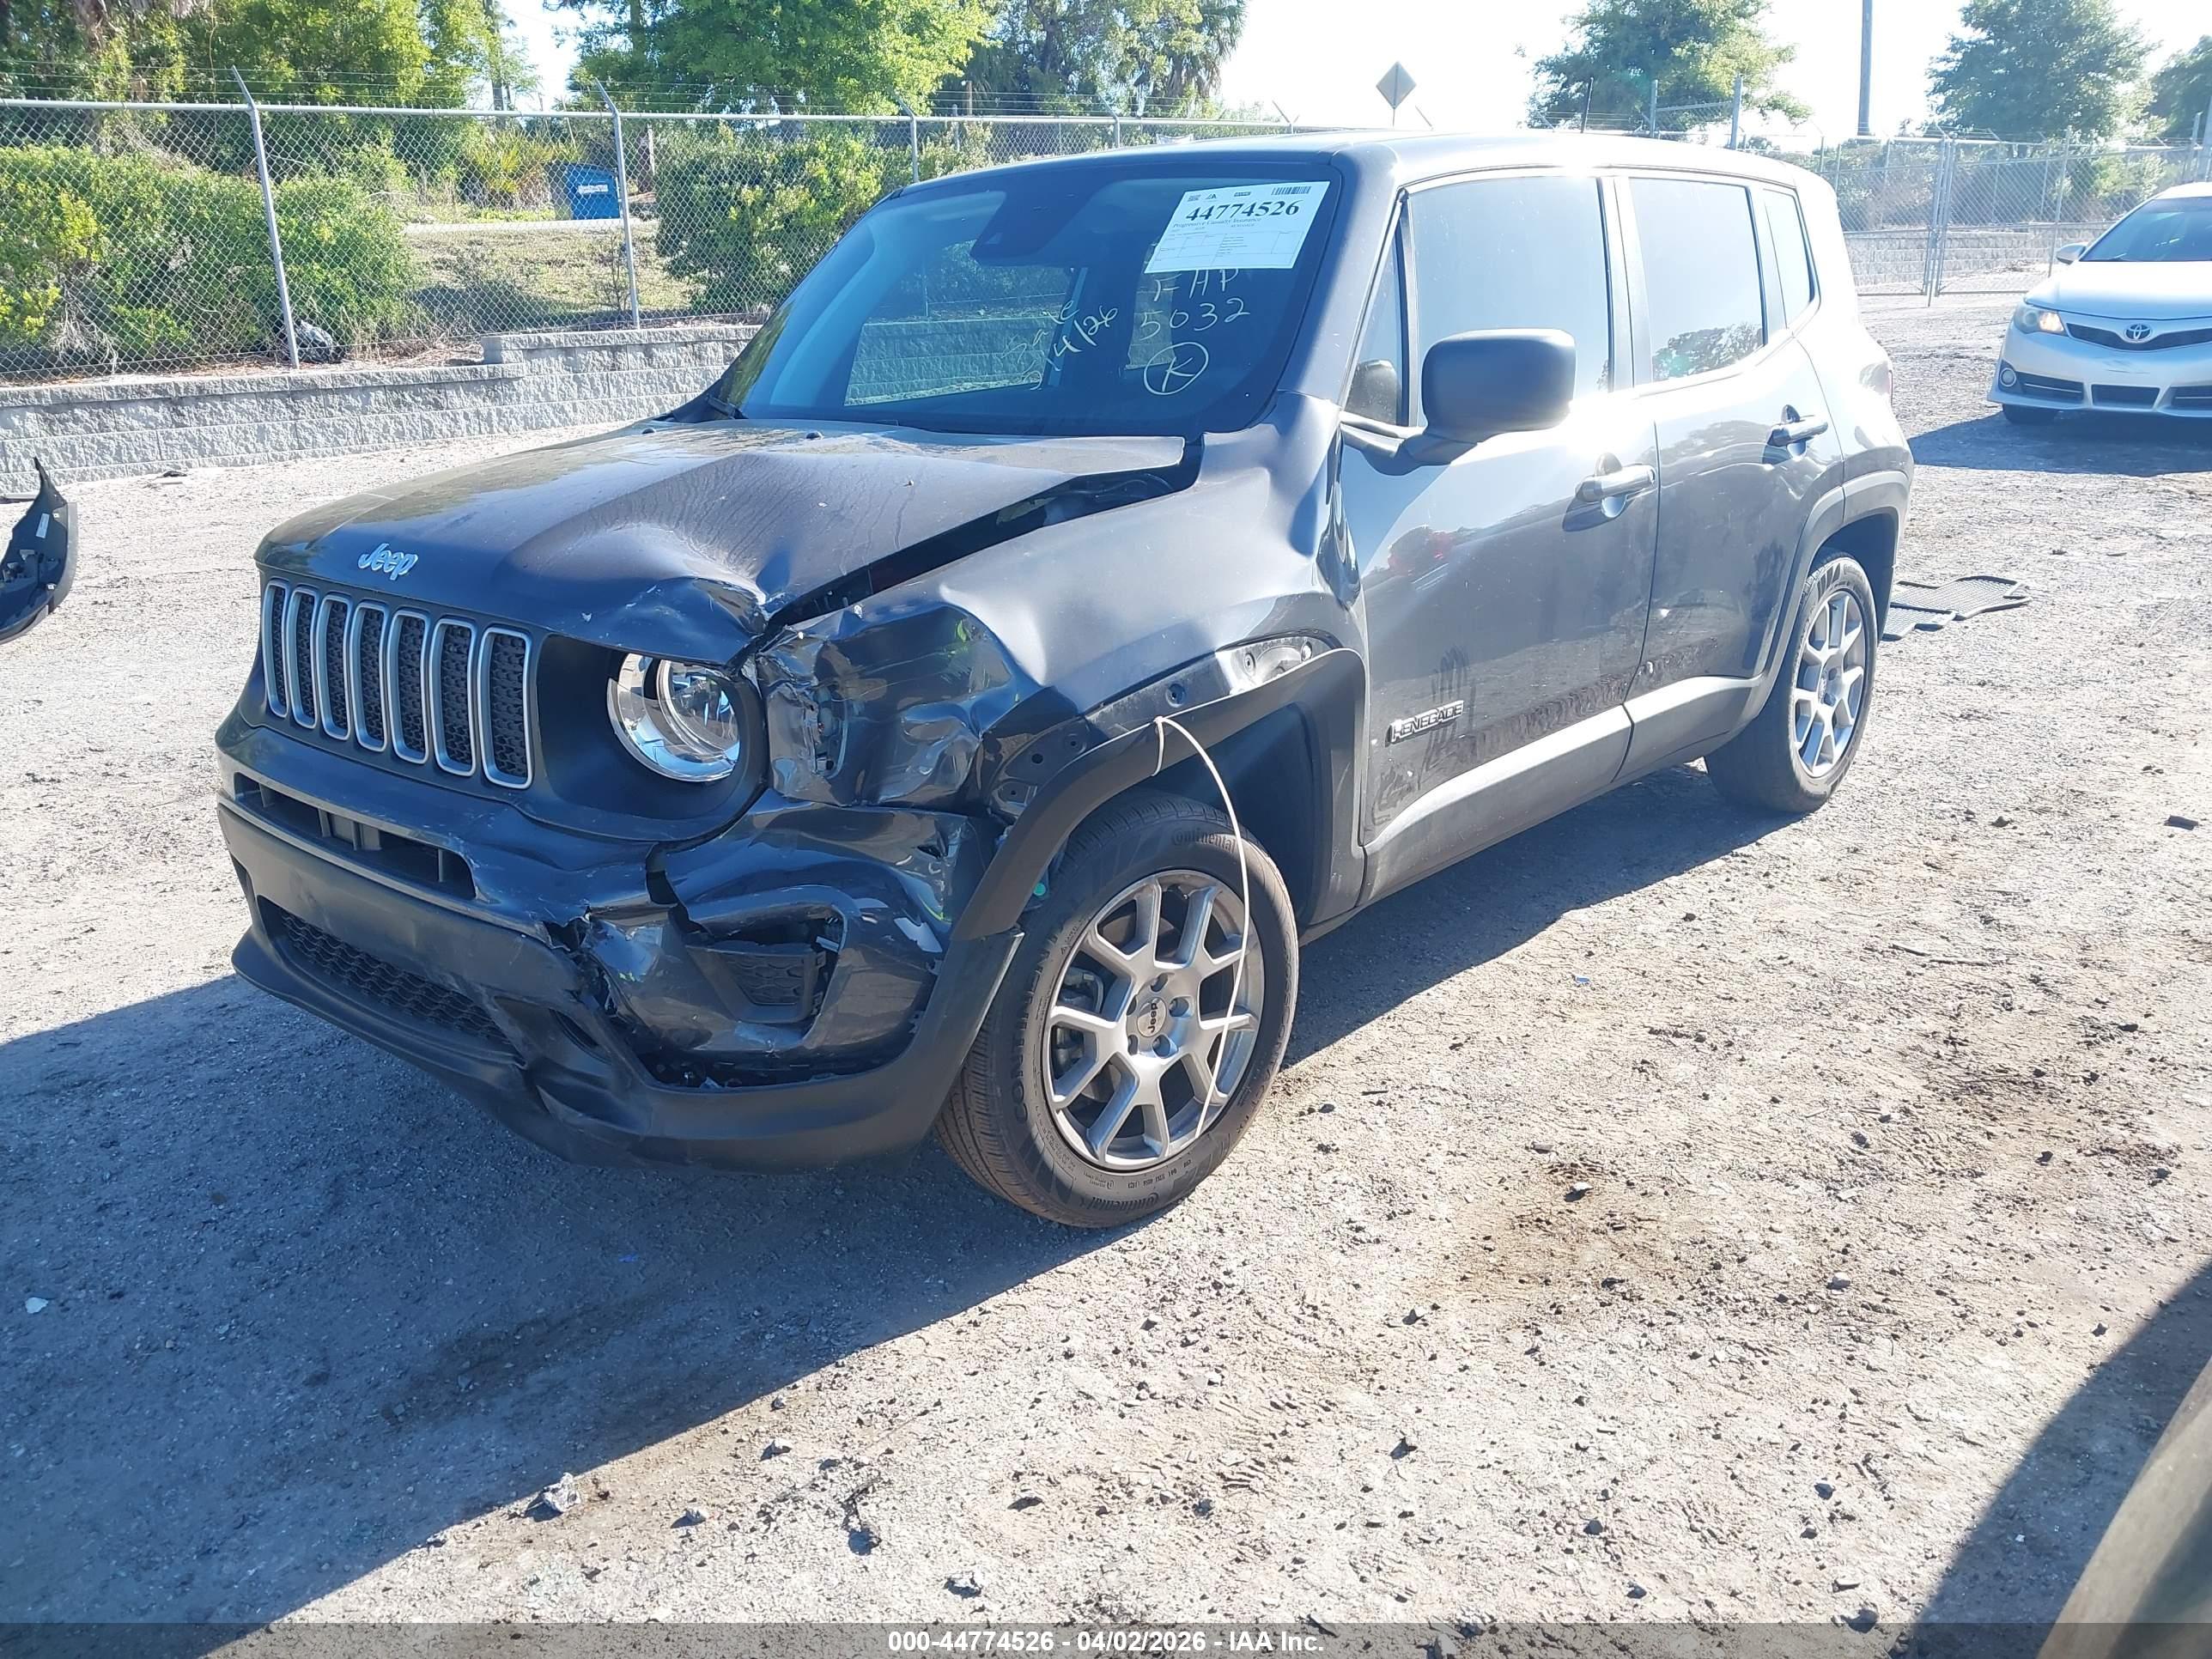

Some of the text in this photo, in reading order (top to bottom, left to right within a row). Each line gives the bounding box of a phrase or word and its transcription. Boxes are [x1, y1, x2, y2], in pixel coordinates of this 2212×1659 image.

[1185, 199, 1304, 222] 44774526
[1139, 297, 1251, 341] 5032
[357, 543, 419, 581] Jeep
[1390, 700, 1464, 744] RENEGADE
[1146, 1002, 1158, 1034] Jeep
[1086, 1192, 1159, 1212] Continental
